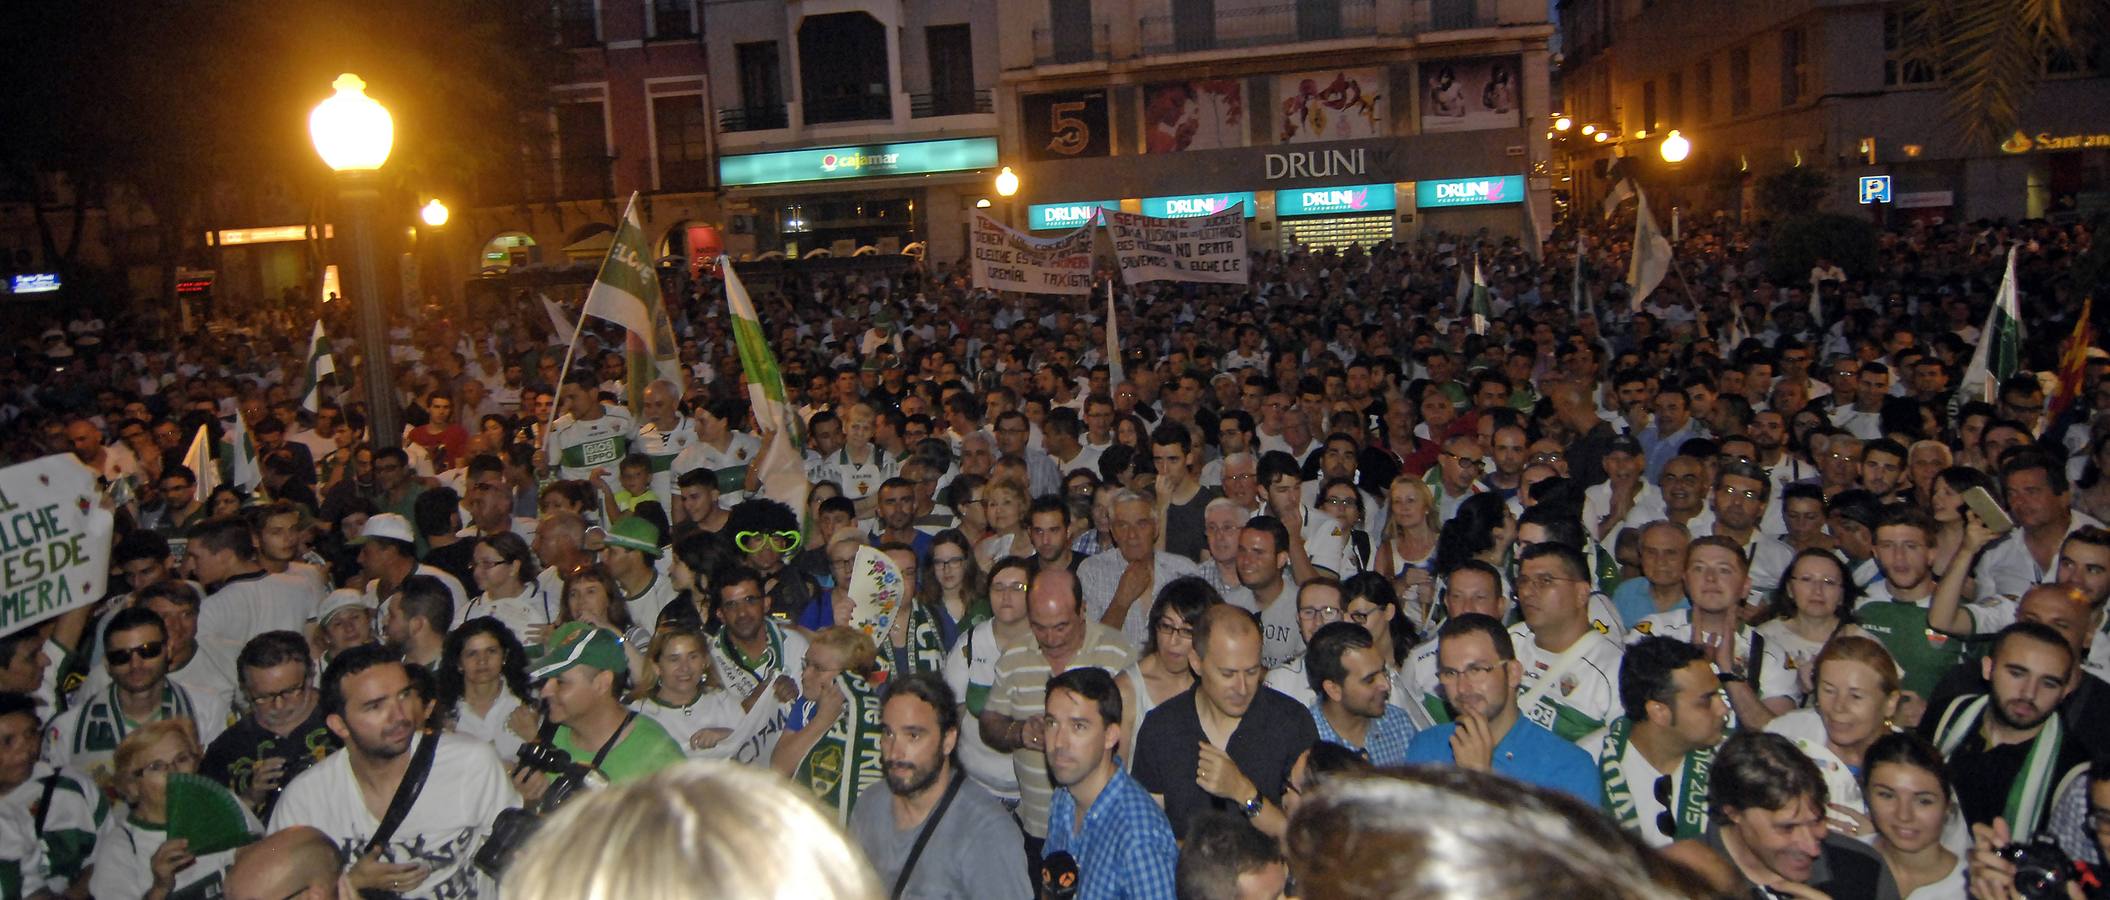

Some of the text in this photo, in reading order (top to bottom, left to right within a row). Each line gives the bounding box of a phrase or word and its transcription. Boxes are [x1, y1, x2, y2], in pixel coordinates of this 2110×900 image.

[2035, 132, 2110, 151] Santan
[838, 152, 900, 170] cajamar
[1265, 148, 1366, 180] DRUNI
[1302, 190, 1353, 207] DRUNI
[1436, 181, 1489, 199] DRUNI
[1866, 180, 1884, 200] P
[1044, 206, 1091, 222] DRUNI
[1166, 197, 1215, 215] DRUNI
[1176, 242, 1192, 258] NO
[1199, 240, 1234, 256] GRATA
[1190, 260, 1220, 273] ELCHE
[0, 504, 69, 556] LCHE
[0, 573, 73, 628] MERA
[1264, 624, 1291, 643] ON
